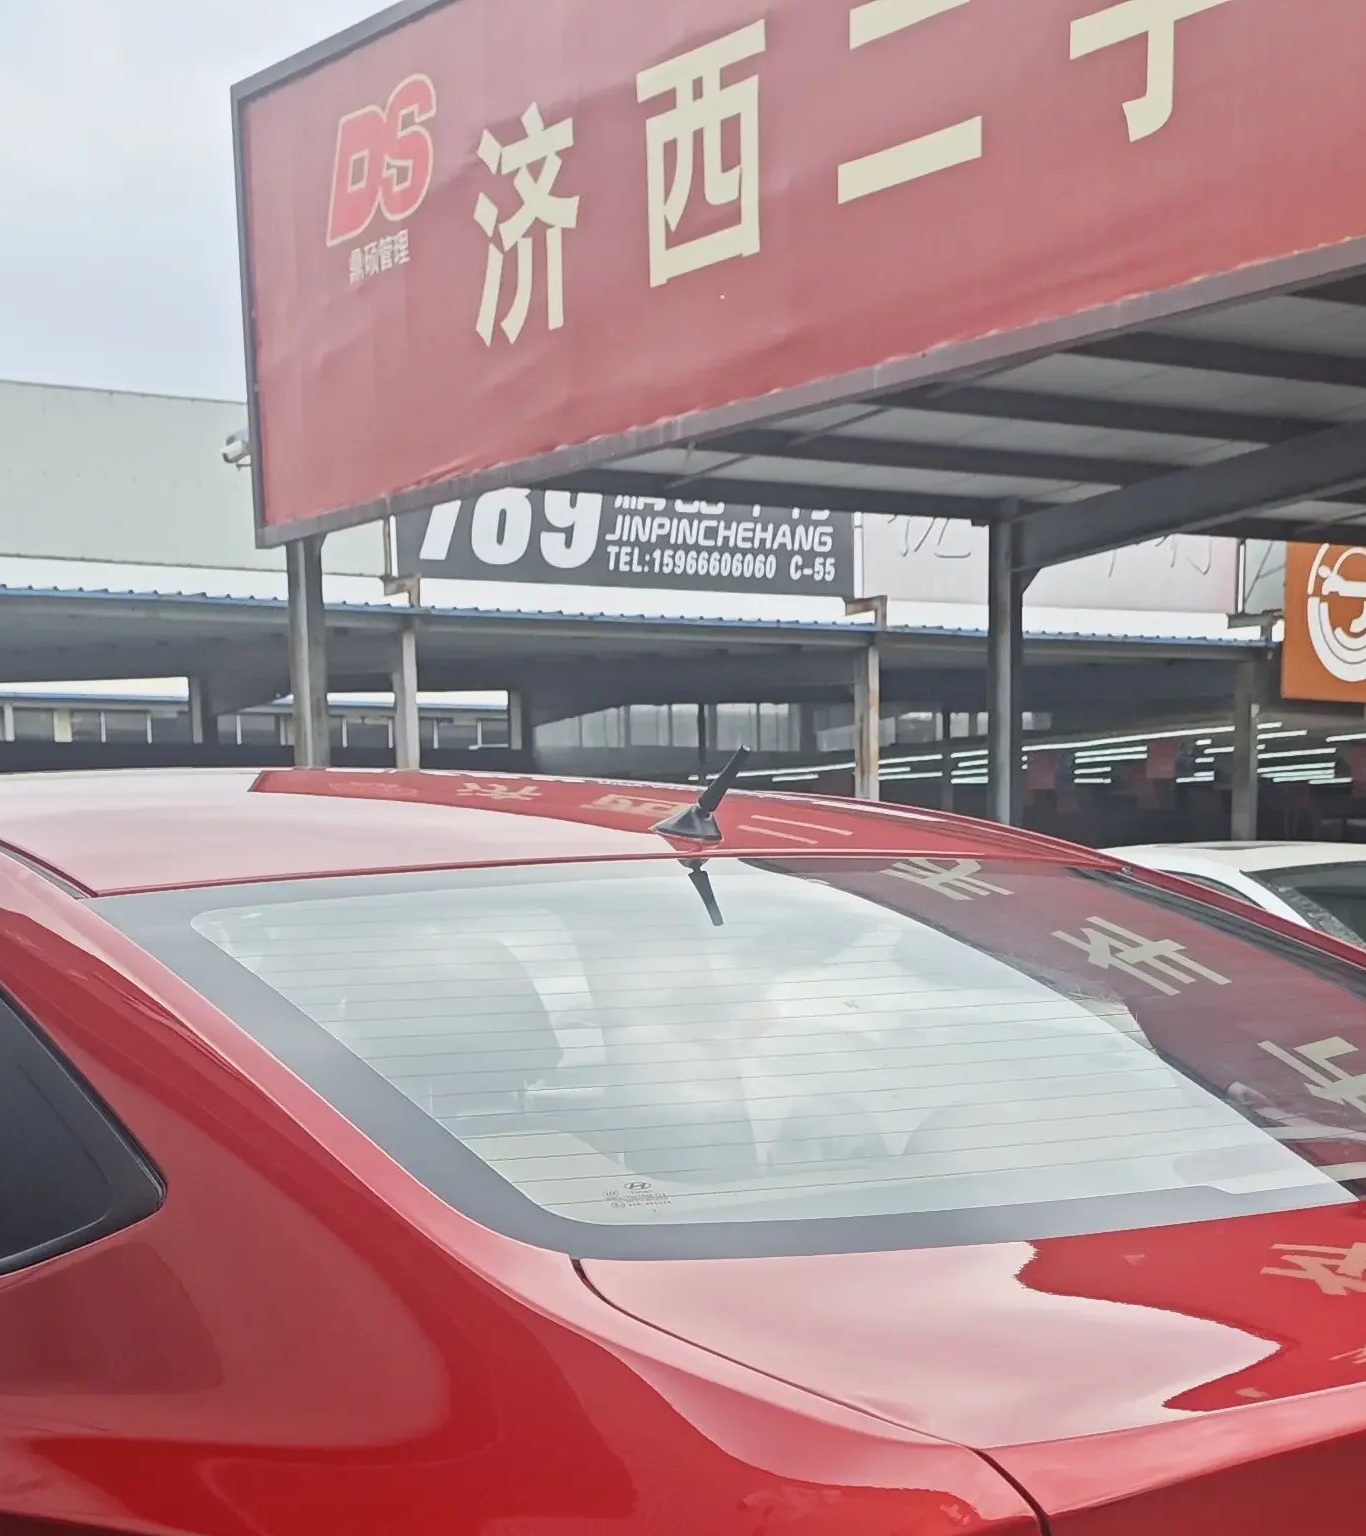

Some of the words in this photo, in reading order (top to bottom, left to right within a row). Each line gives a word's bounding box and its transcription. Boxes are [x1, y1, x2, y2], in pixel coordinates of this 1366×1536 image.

[326, 73, 437, 247] DS
[605, 514, 834, 553] JINPINCHEHANG
[607, 544, 777, 579] TEL:15966606060
[789, 554, 836, 582] C-55
